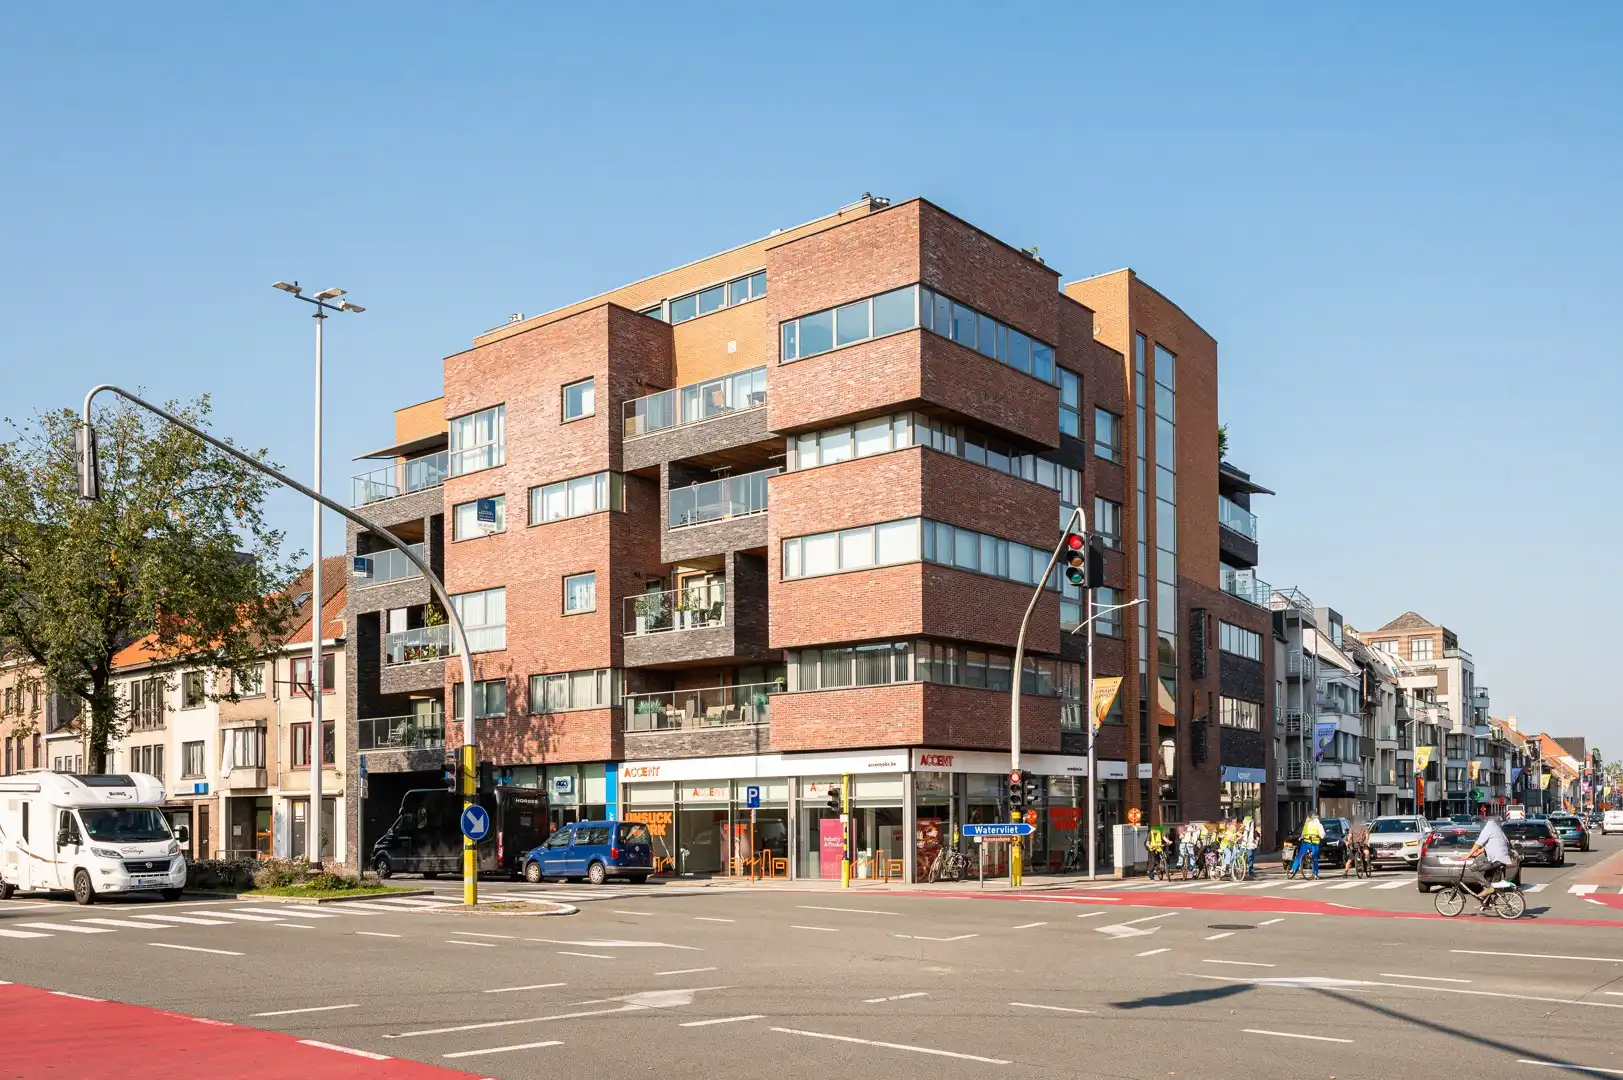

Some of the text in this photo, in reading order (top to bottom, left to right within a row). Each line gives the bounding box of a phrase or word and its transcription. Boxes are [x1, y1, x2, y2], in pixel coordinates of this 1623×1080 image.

[920, 754, 953, 767] ACCENT
[624, 766, 660, 778] ACCENT
[748, 788, 758, 804] P
[625, 812, 672, 824] UNSUCK
[975, 826, 1018, 834] Watervliet
